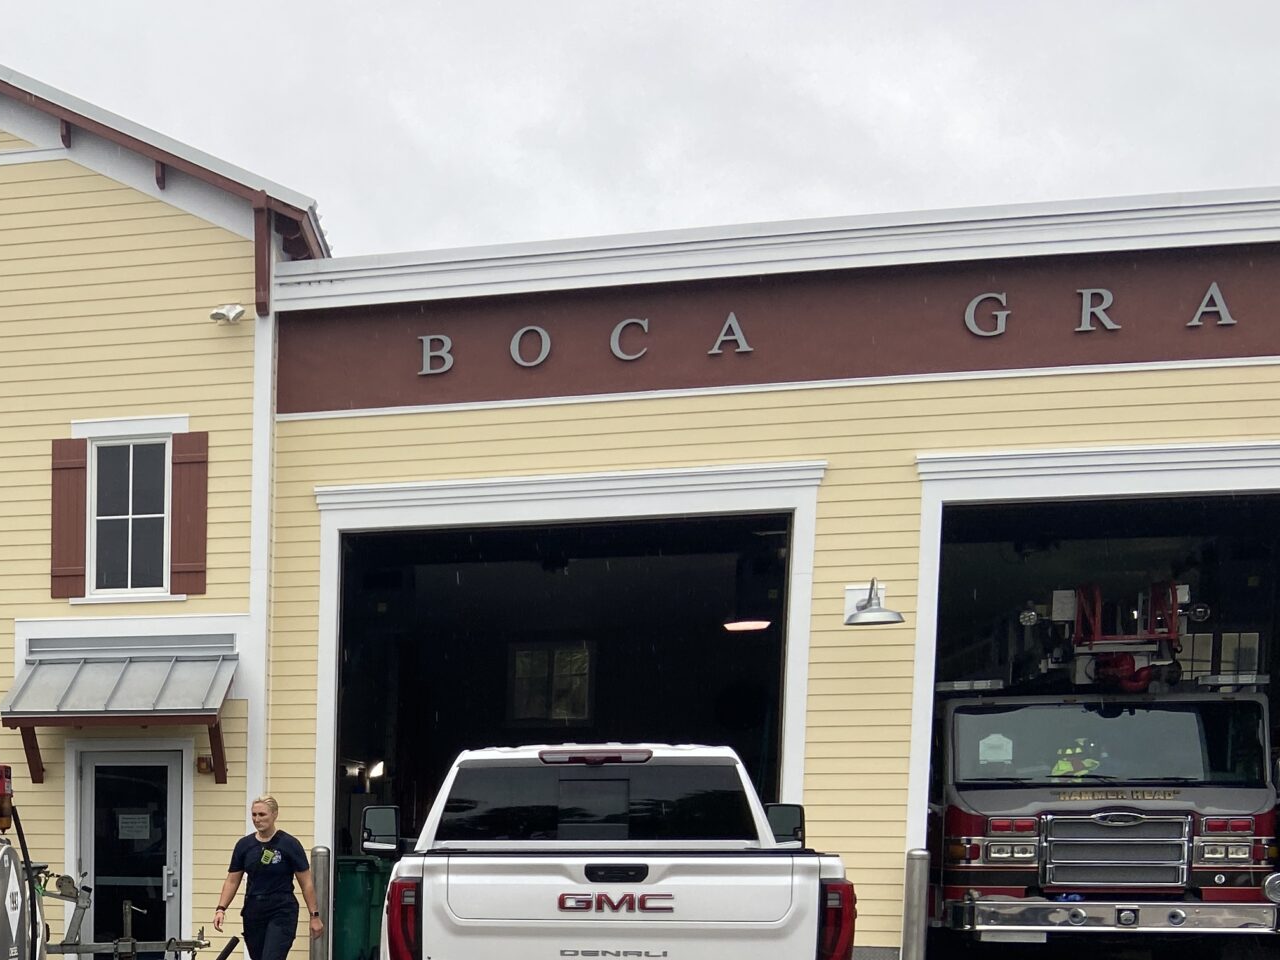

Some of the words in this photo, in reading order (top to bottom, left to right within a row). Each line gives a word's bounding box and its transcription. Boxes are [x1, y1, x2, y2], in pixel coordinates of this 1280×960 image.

[417, 311, 754, 376] BOCA
[964, 281, 1238, 337] GRA
[557, 892, 675, 914] GMC
[560, 949, 668, 958] DENALI
